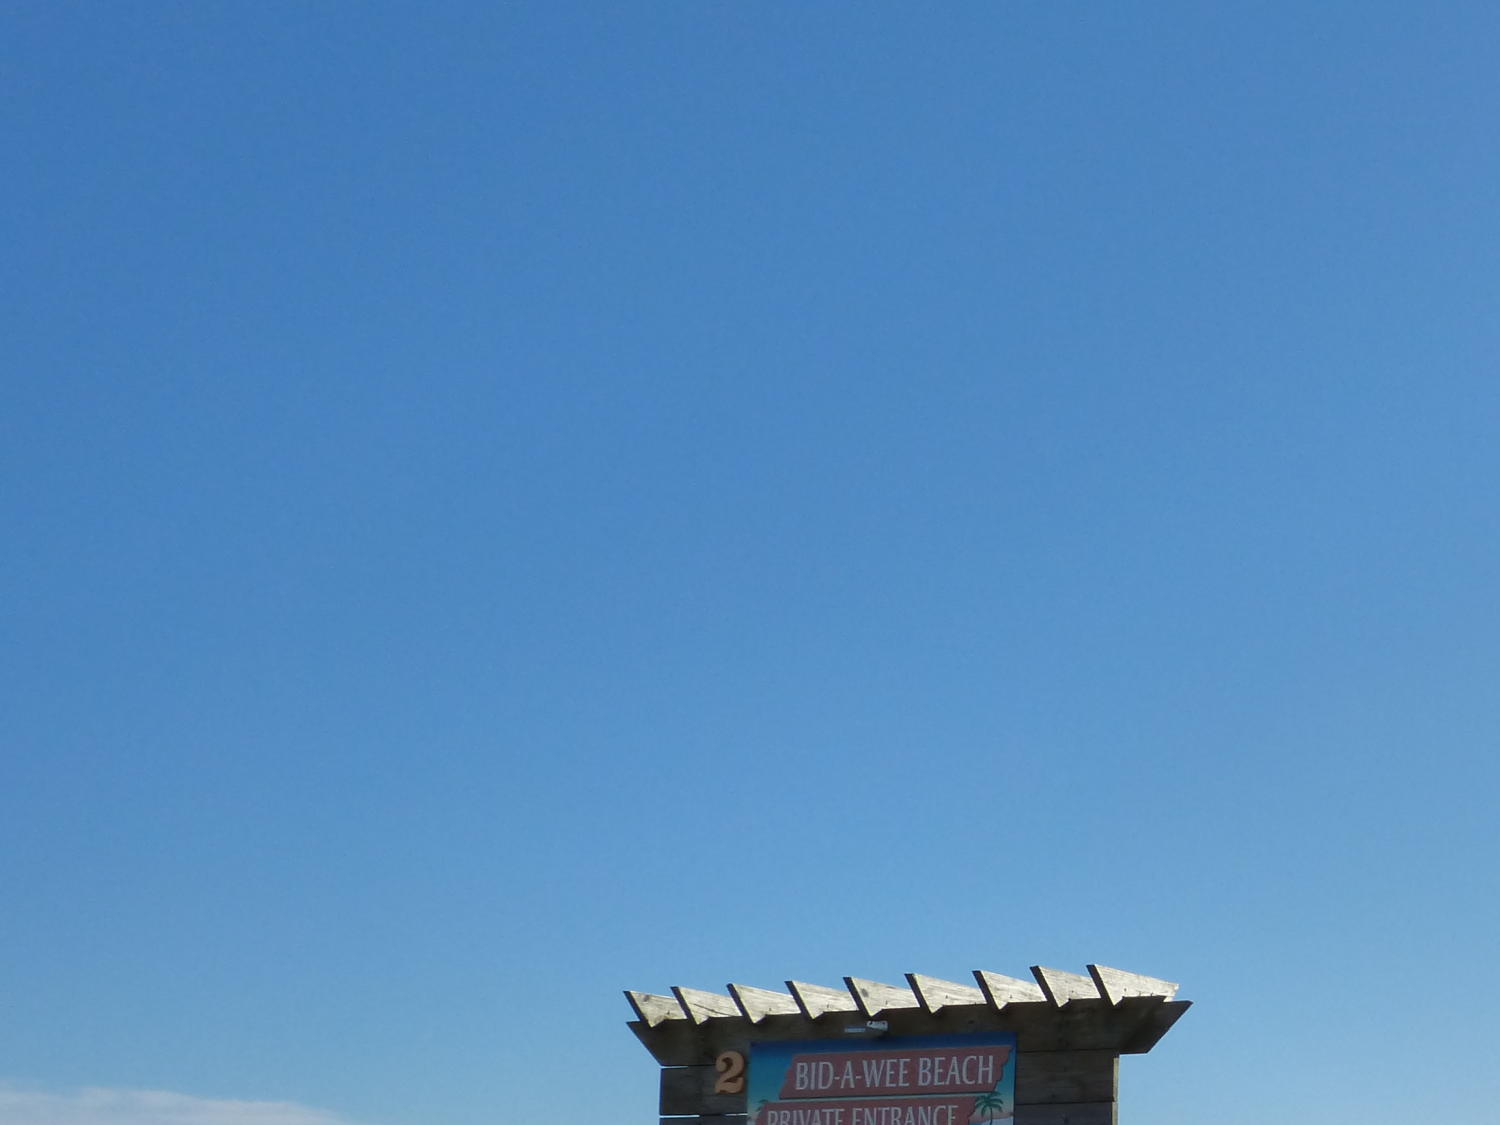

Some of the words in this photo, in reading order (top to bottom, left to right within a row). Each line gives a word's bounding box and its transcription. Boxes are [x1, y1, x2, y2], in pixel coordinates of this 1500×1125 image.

[714, 1050, 746, 1095] 2
[795, 1057, 911, 1091] BID-A-WEE
[917, 1055, 994, 1086] BEACH
